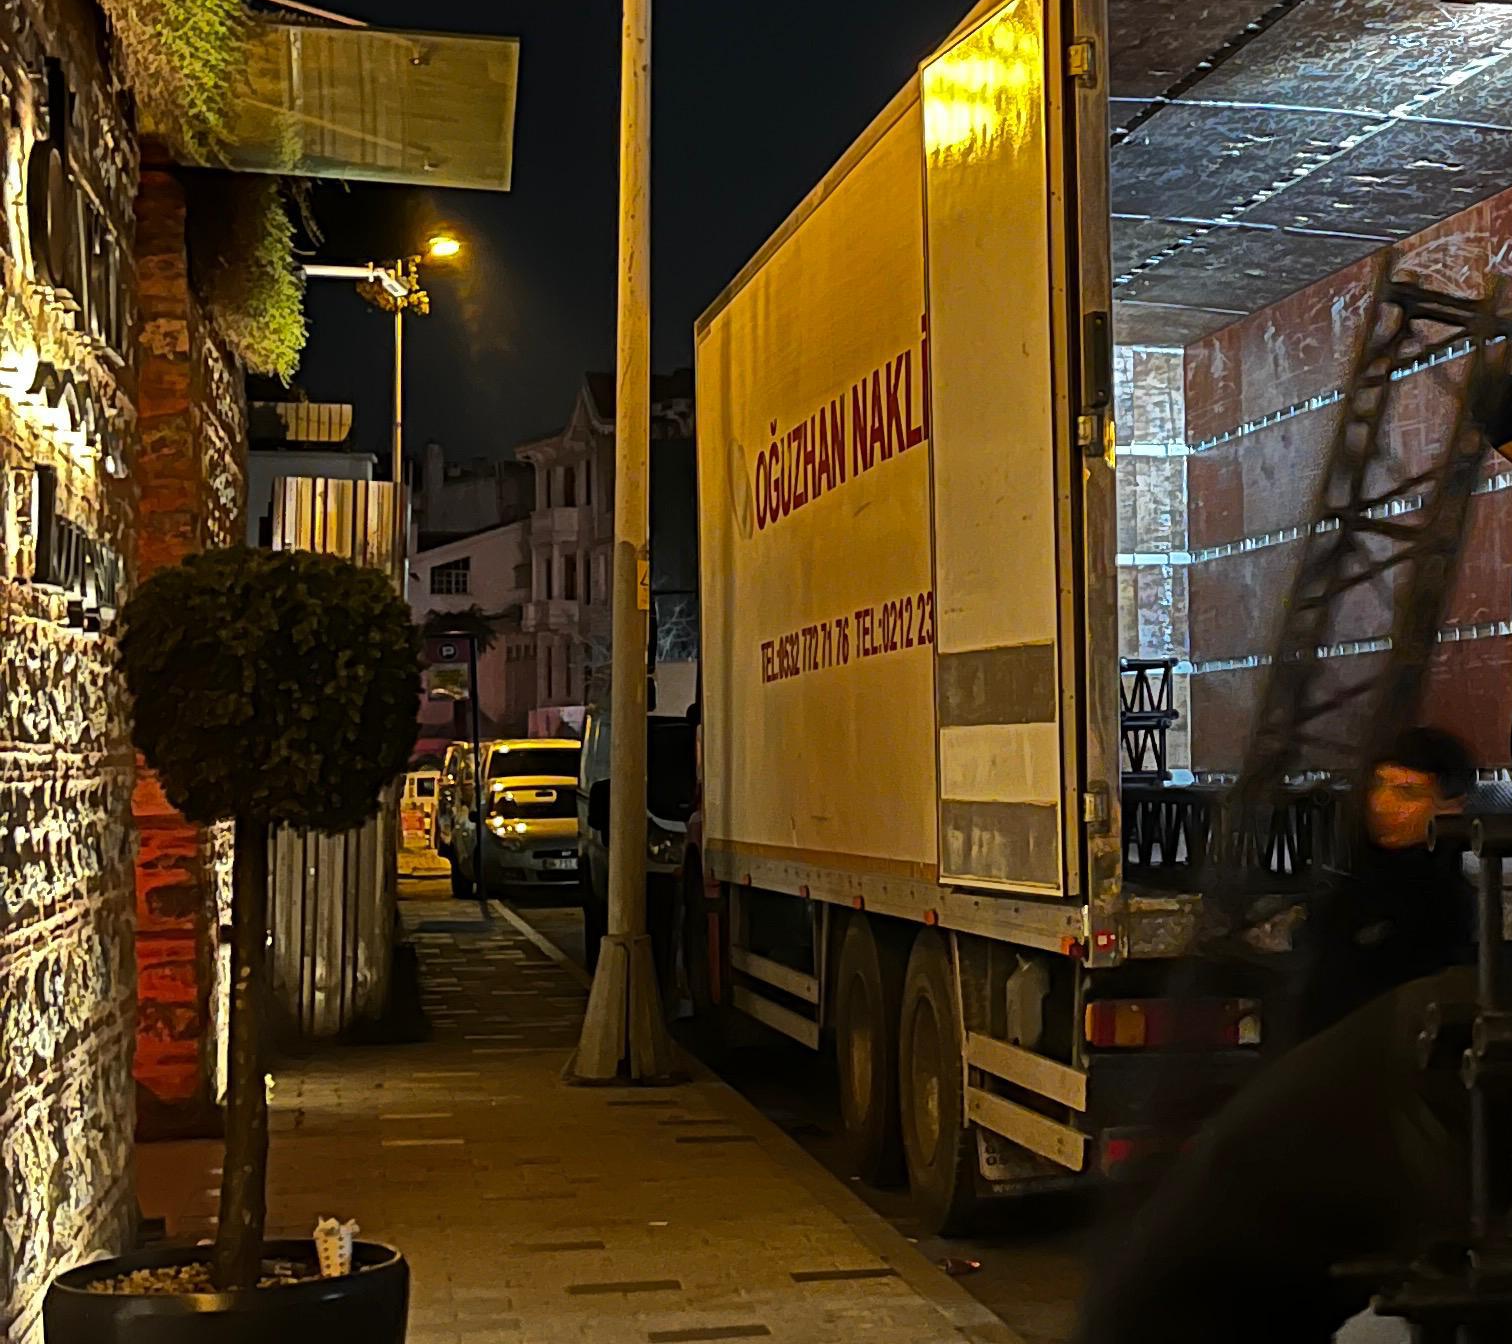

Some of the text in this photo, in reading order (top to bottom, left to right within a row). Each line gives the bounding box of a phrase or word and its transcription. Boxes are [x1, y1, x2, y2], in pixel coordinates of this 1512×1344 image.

[755, 392, 846, 531] OĞUZHAN
[801, 624, 820, 672] 772
[820, 620, 833, 669] 71
[835, 616, 850, 666] 76
[854, 595, 914, 658] TEL:0212
